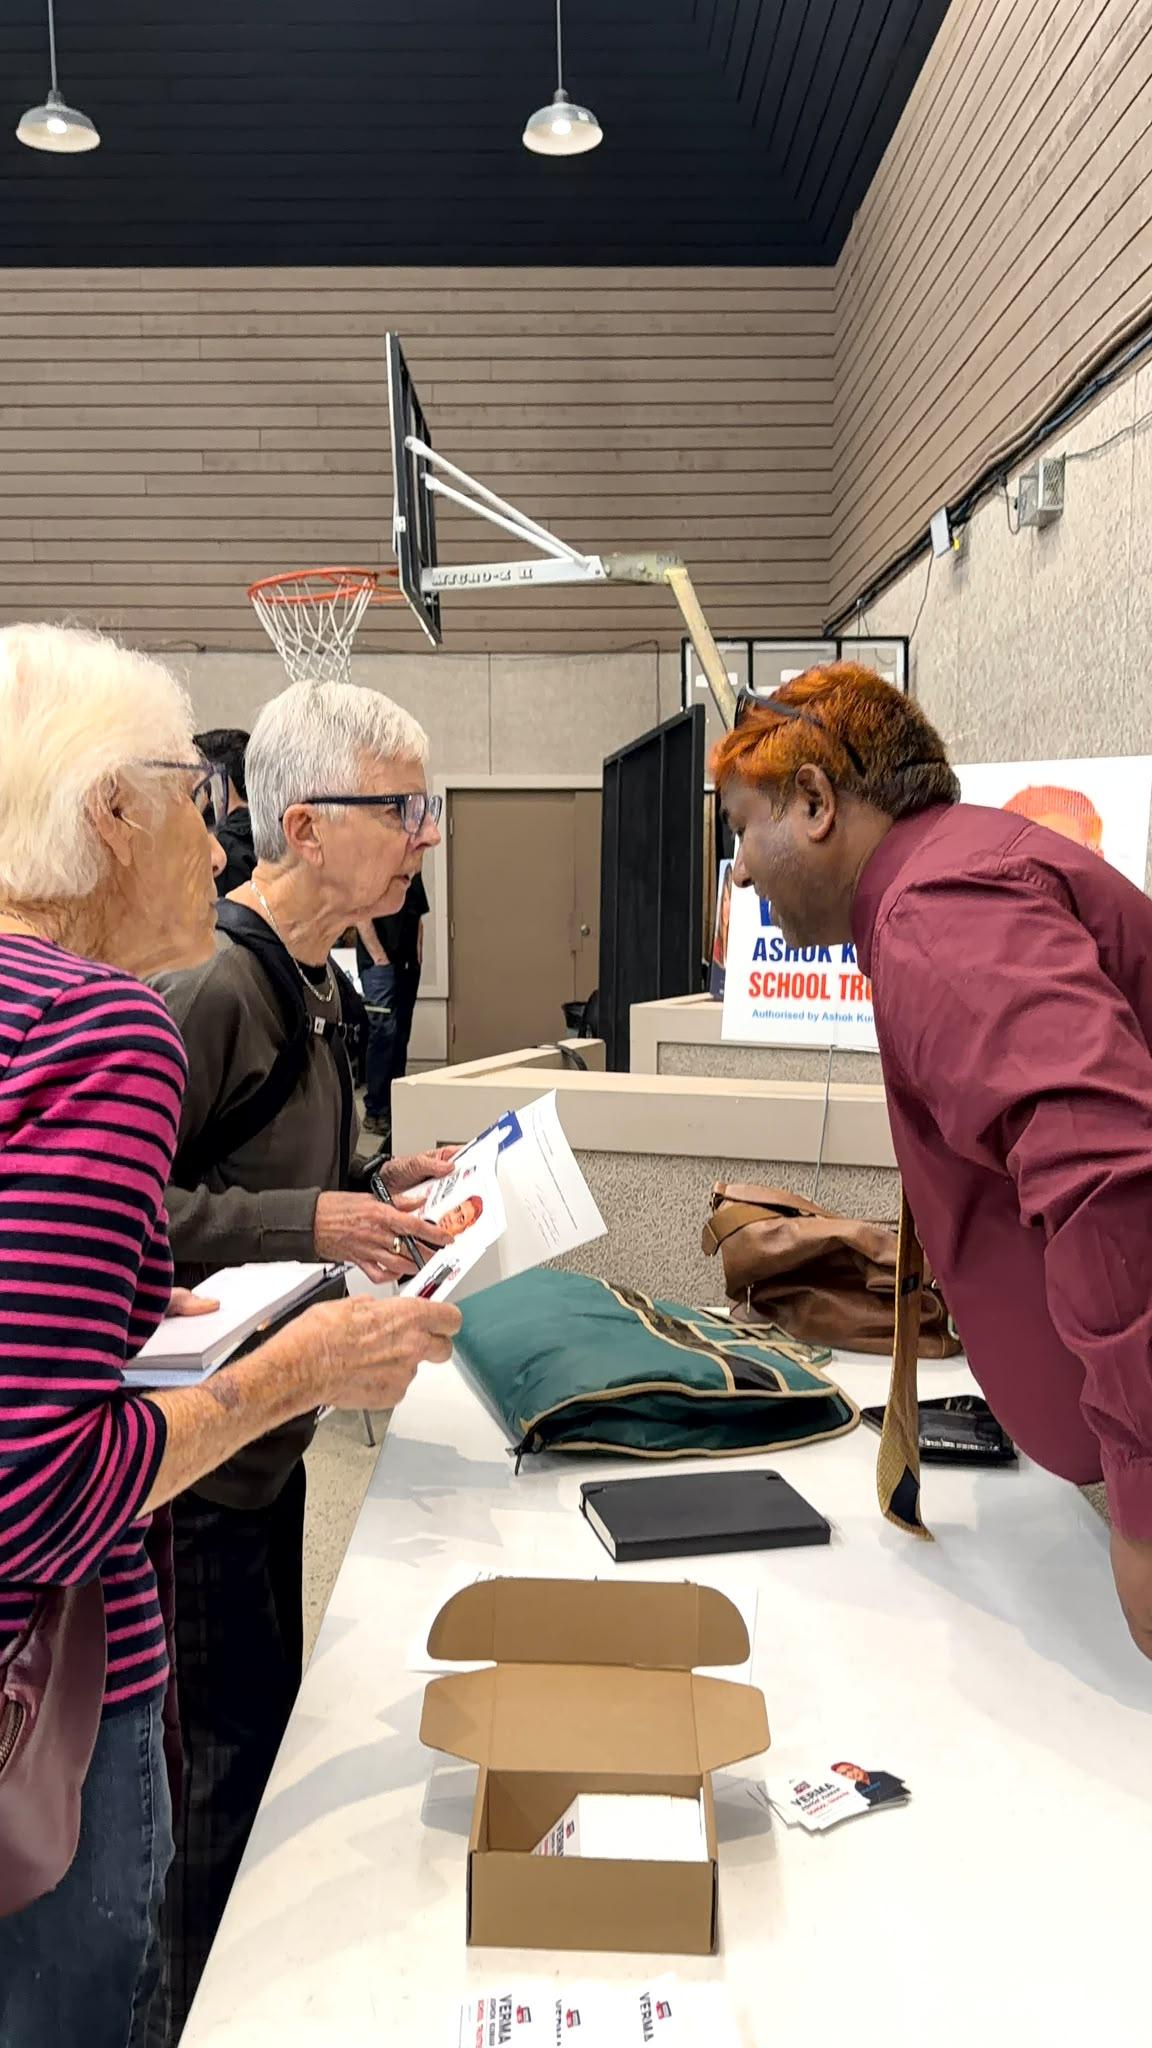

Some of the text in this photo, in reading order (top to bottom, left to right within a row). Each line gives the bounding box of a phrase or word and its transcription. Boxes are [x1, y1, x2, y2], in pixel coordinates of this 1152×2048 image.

[752, 937, 832, 963] ASHOK
[748, 971, 831, 1000] SCHOOL
[752, 1009, 805, 1021] Authorised
[807, 1010, 820, 1023] by
[822, 1011, 854, 1022] Ashok
[498, 1993, 513, 2045] VERMA
[639, 1992, 654, 2043] VERMA
